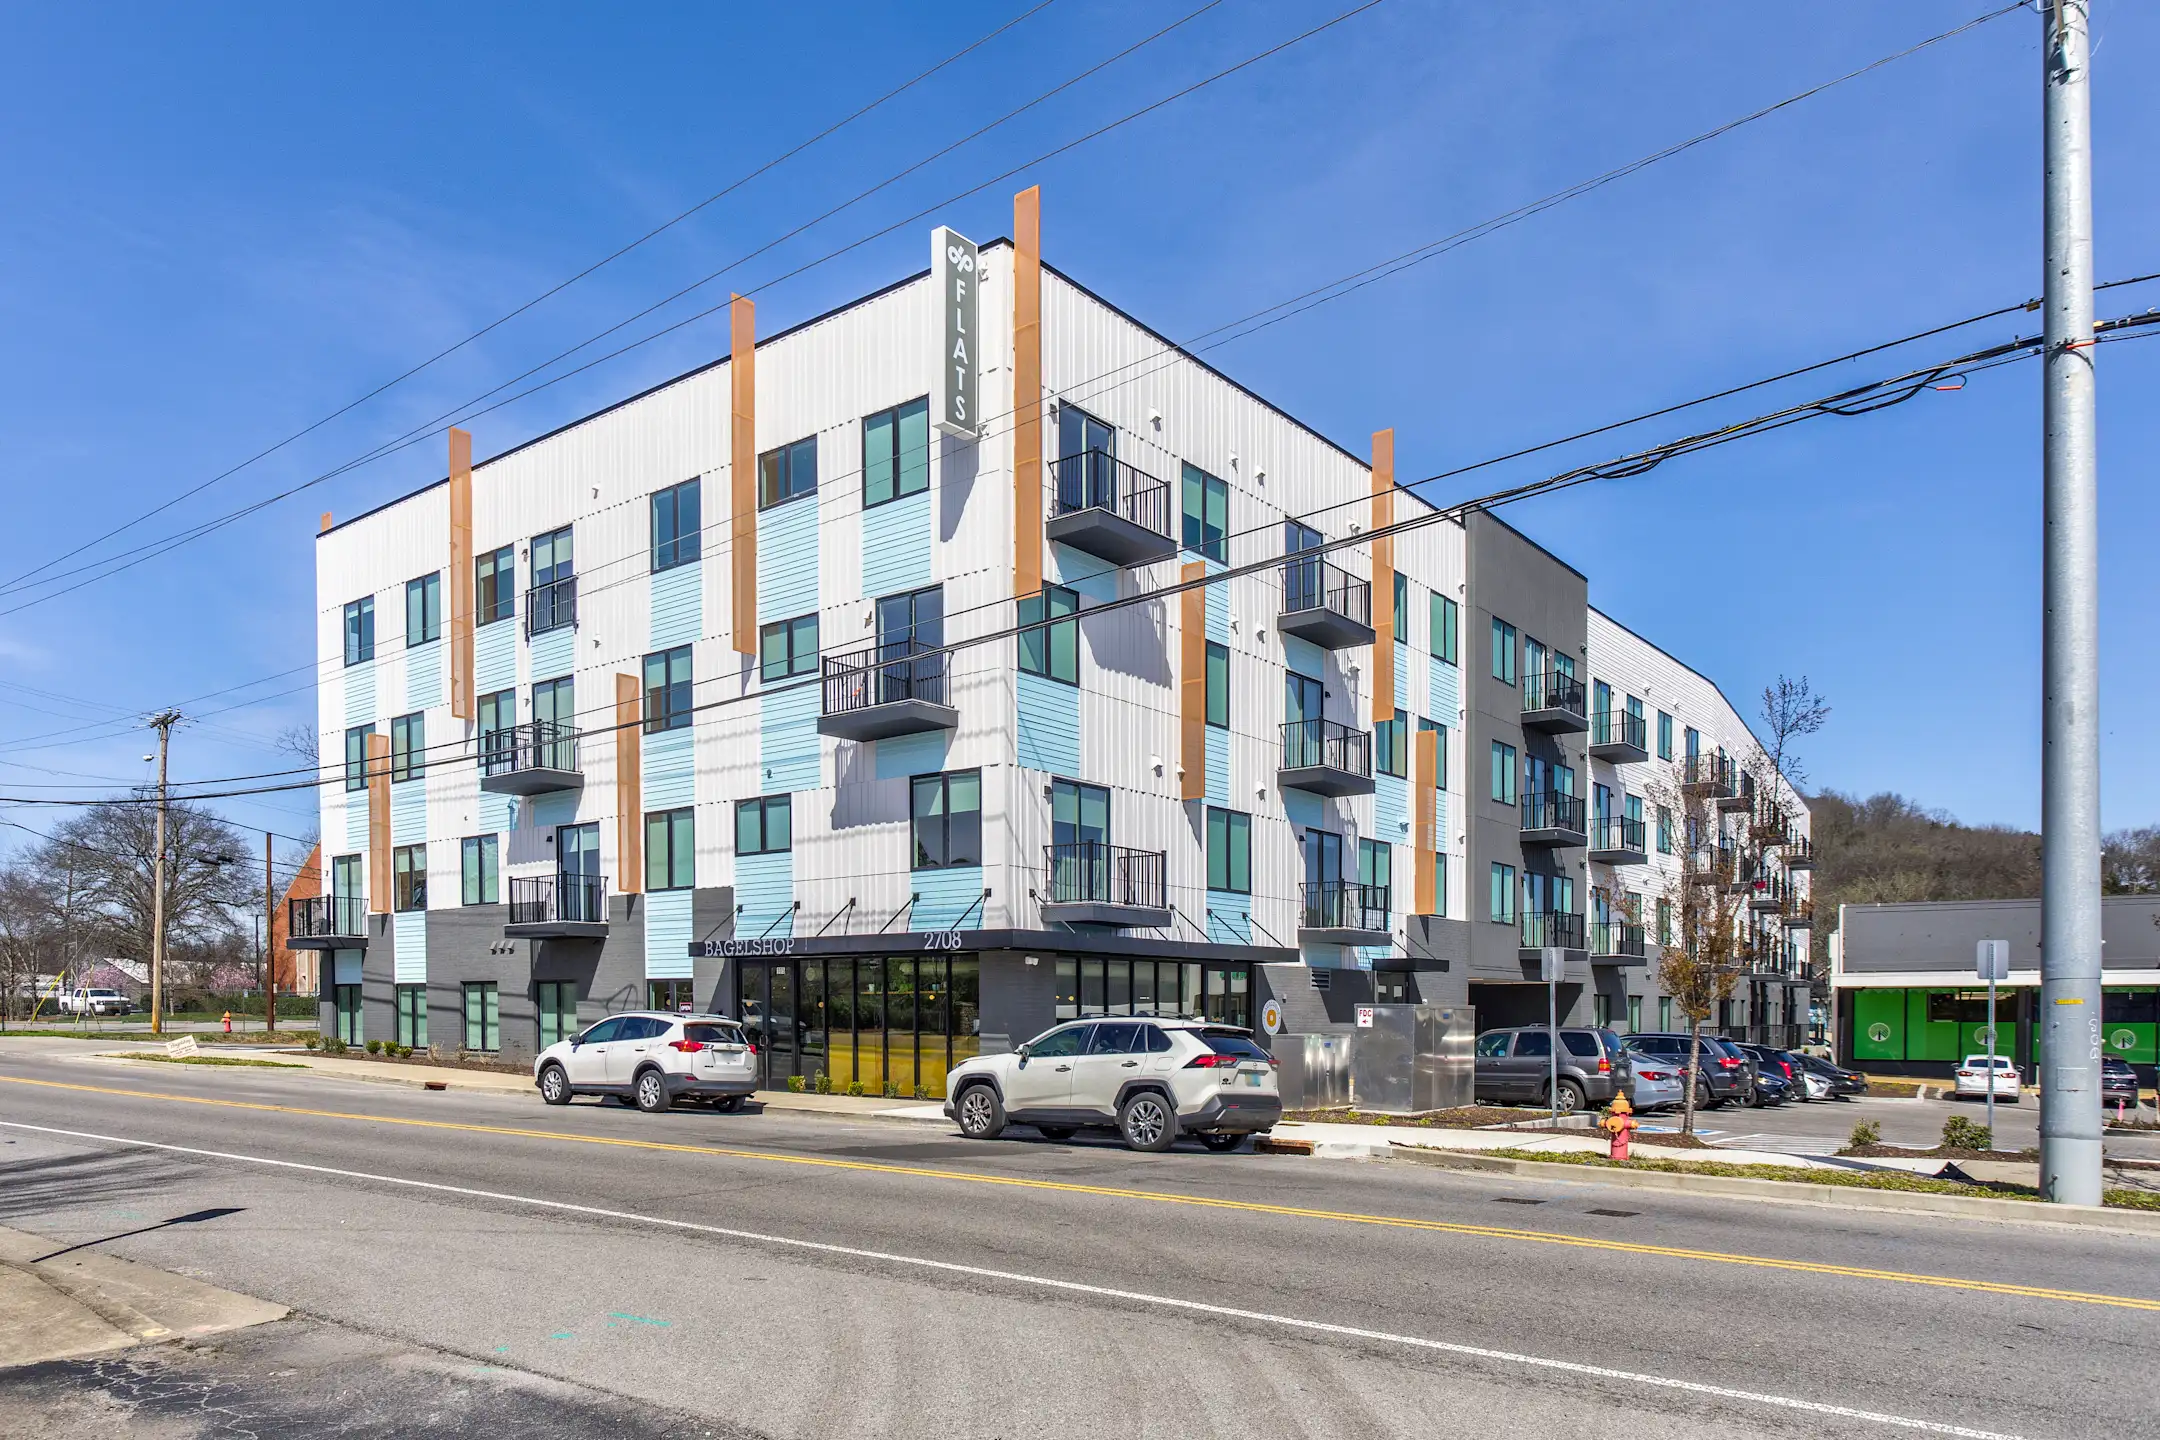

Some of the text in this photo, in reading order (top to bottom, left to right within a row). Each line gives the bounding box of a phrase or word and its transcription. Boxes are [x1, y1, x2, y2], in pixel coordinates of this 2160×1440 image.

[953, 278, 969, 421] FLATS
[704, 938, 795, 957] BAGELSHOP
[924, 930, 962, 950] 2708
[1358, 1009, 1372, 1017] FDC
